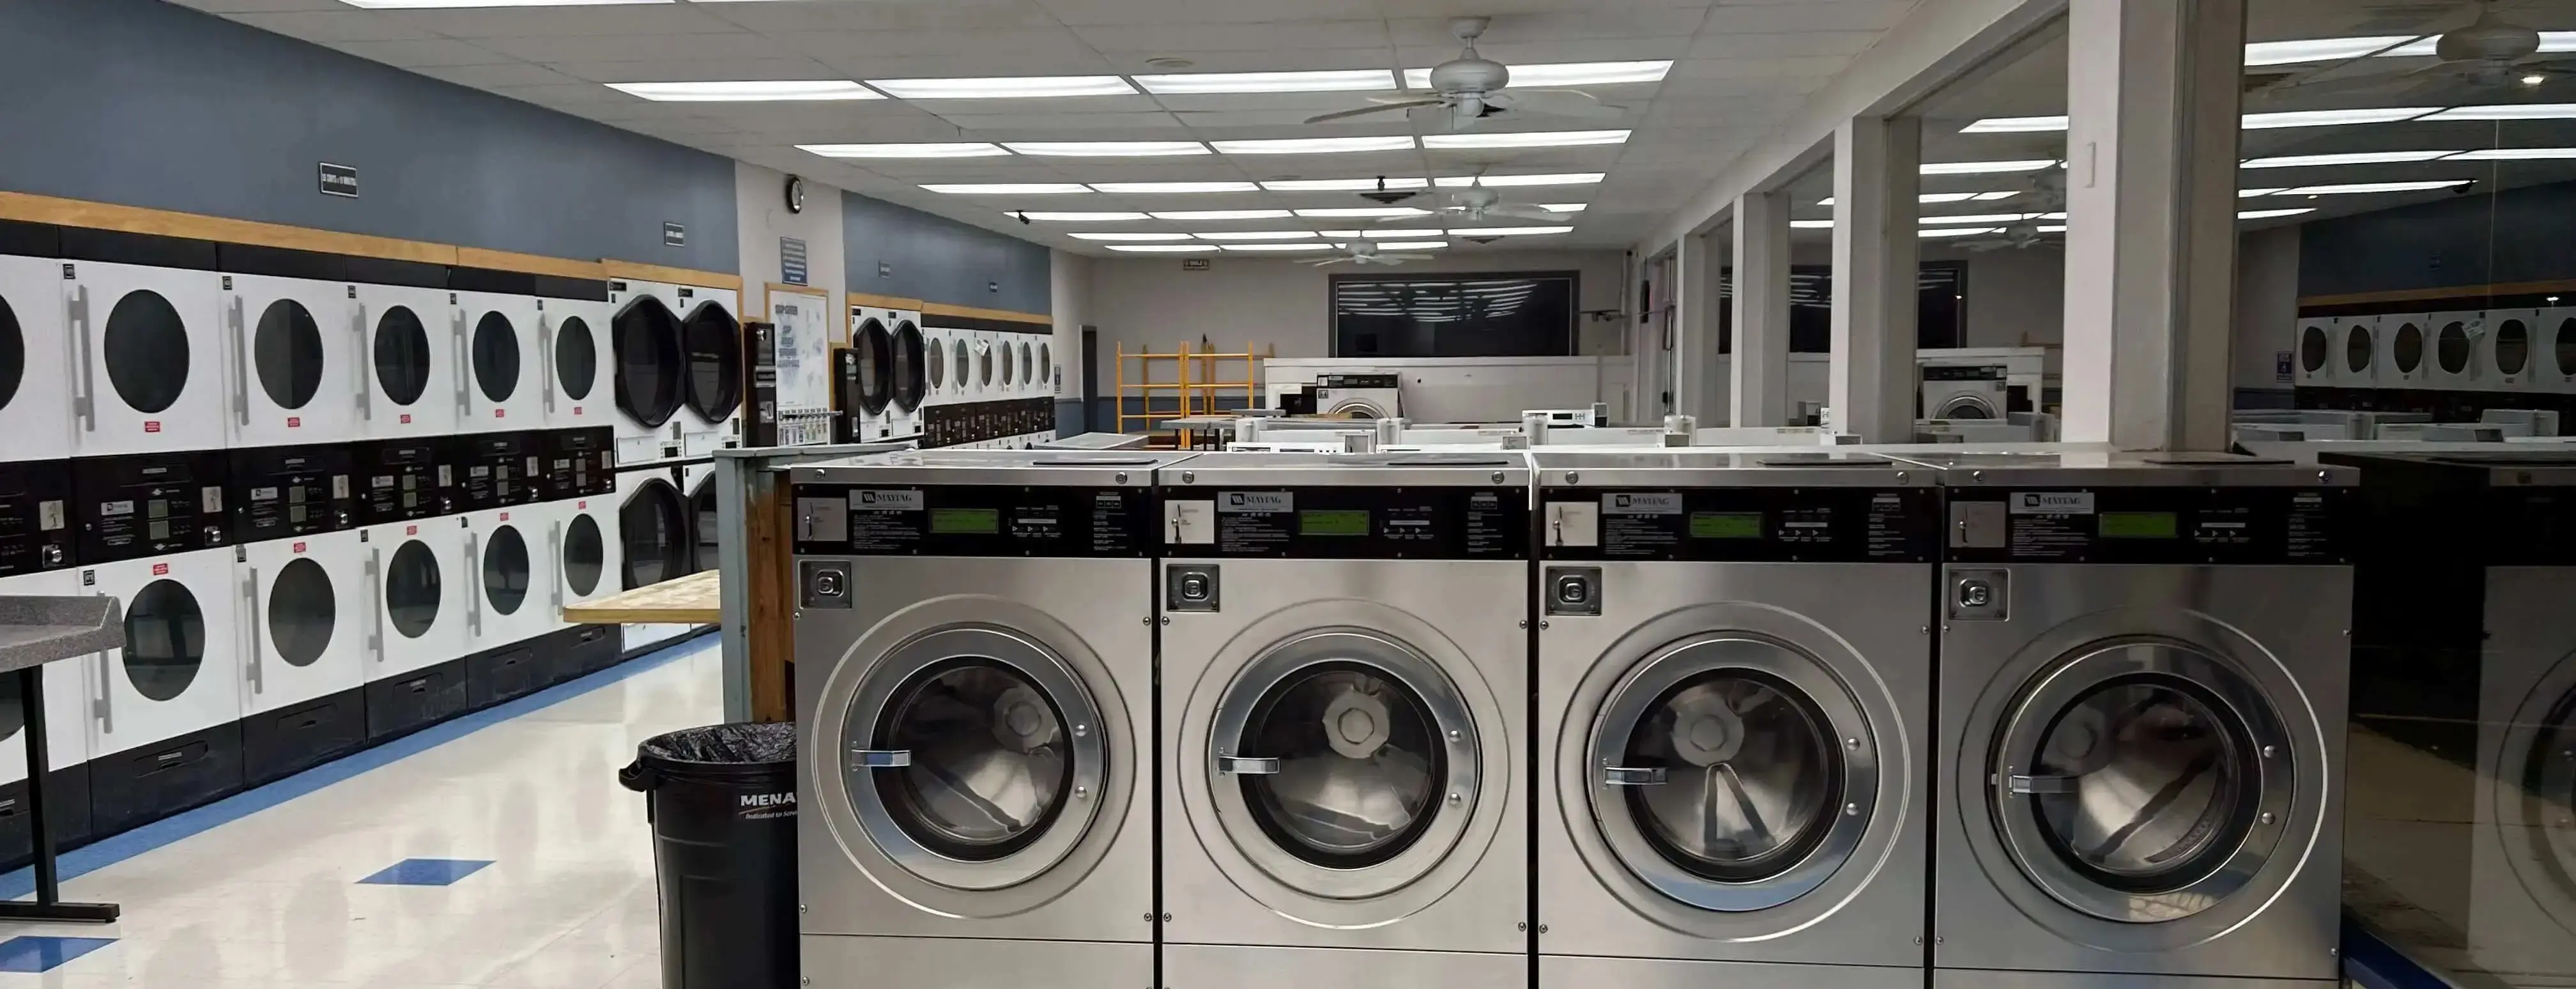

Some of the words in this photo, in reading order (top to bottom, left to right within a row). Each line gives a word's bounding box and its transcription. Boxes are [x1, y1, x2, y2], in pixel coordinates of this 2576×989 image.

[877, 494, 912, 502] MAYTAG
[1246, 495, 1282, 504] MAYTAG
[1632, 496, 1669, 505] MAYTAG
[2042, 496, 2081, 505] MAYTAG
[740, 792, 797, 806] MENA
